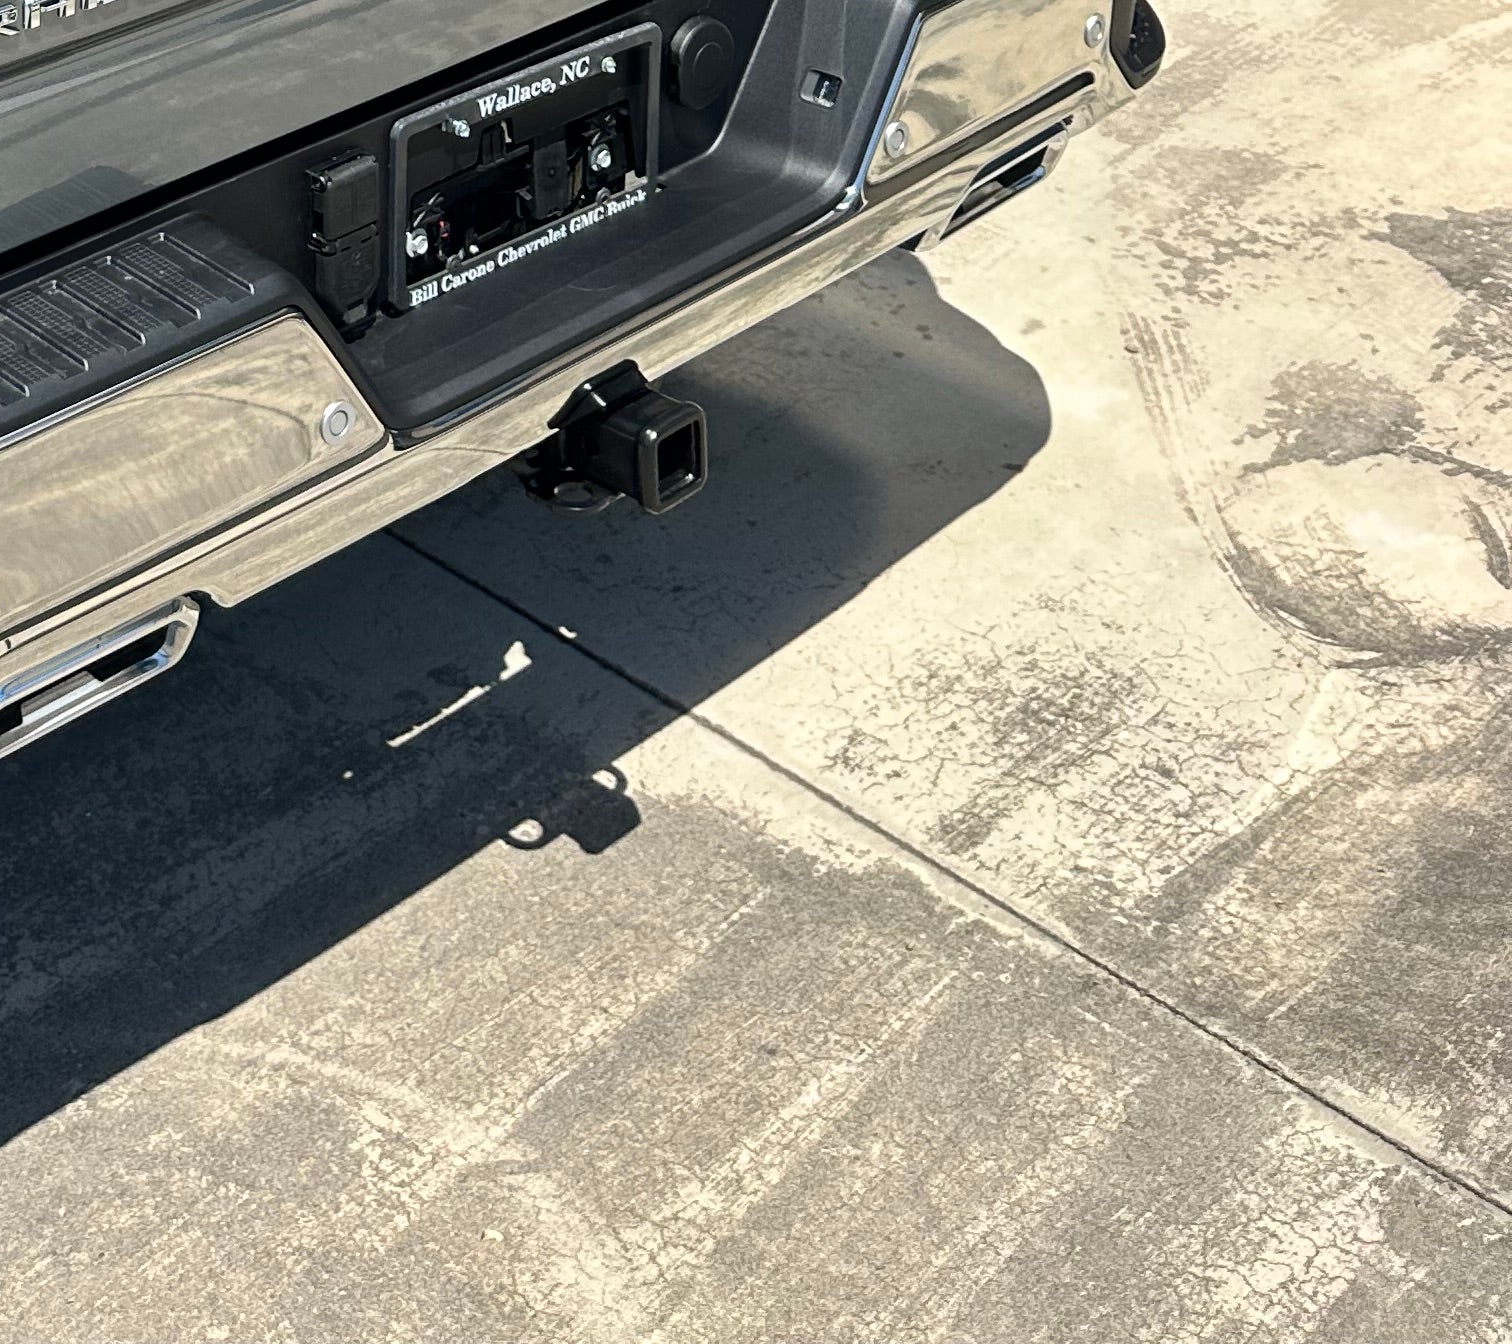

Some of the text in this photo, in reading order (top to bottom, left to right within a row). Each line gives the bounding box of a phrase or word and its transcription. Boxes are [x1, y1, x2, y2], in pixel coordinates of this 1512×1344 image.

[477, 55, 590, 118] Wallace, NC
[409, 189, 648, 307] Bill Carone Chevrolet GMC Buick
